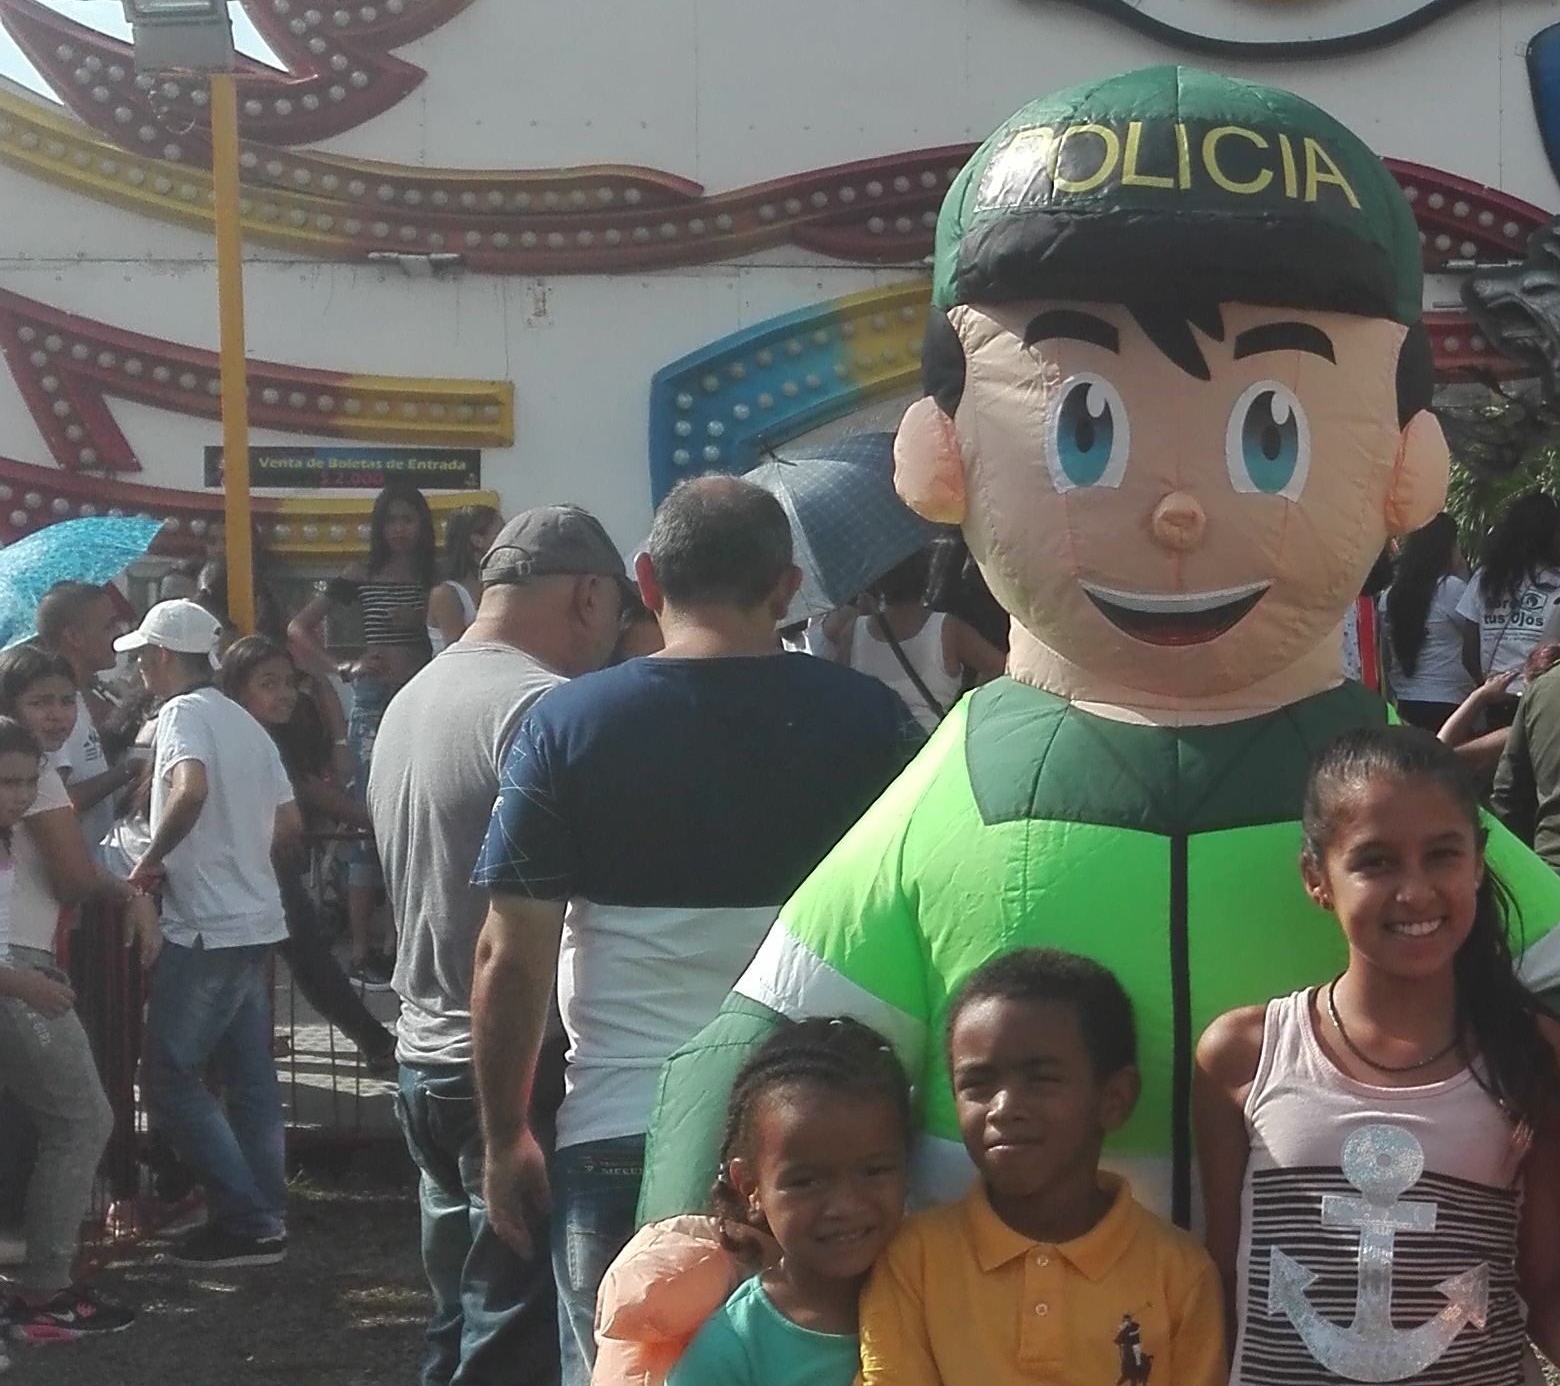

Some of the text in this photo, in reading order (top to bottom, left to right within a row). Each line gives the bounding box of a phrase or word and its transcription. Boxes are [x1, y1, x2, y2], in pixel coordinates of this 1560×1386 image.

[259, 457, 467, 471] Venta de Boletas de Entrada
[1484, 612, 1544, 627] tus Ojos
